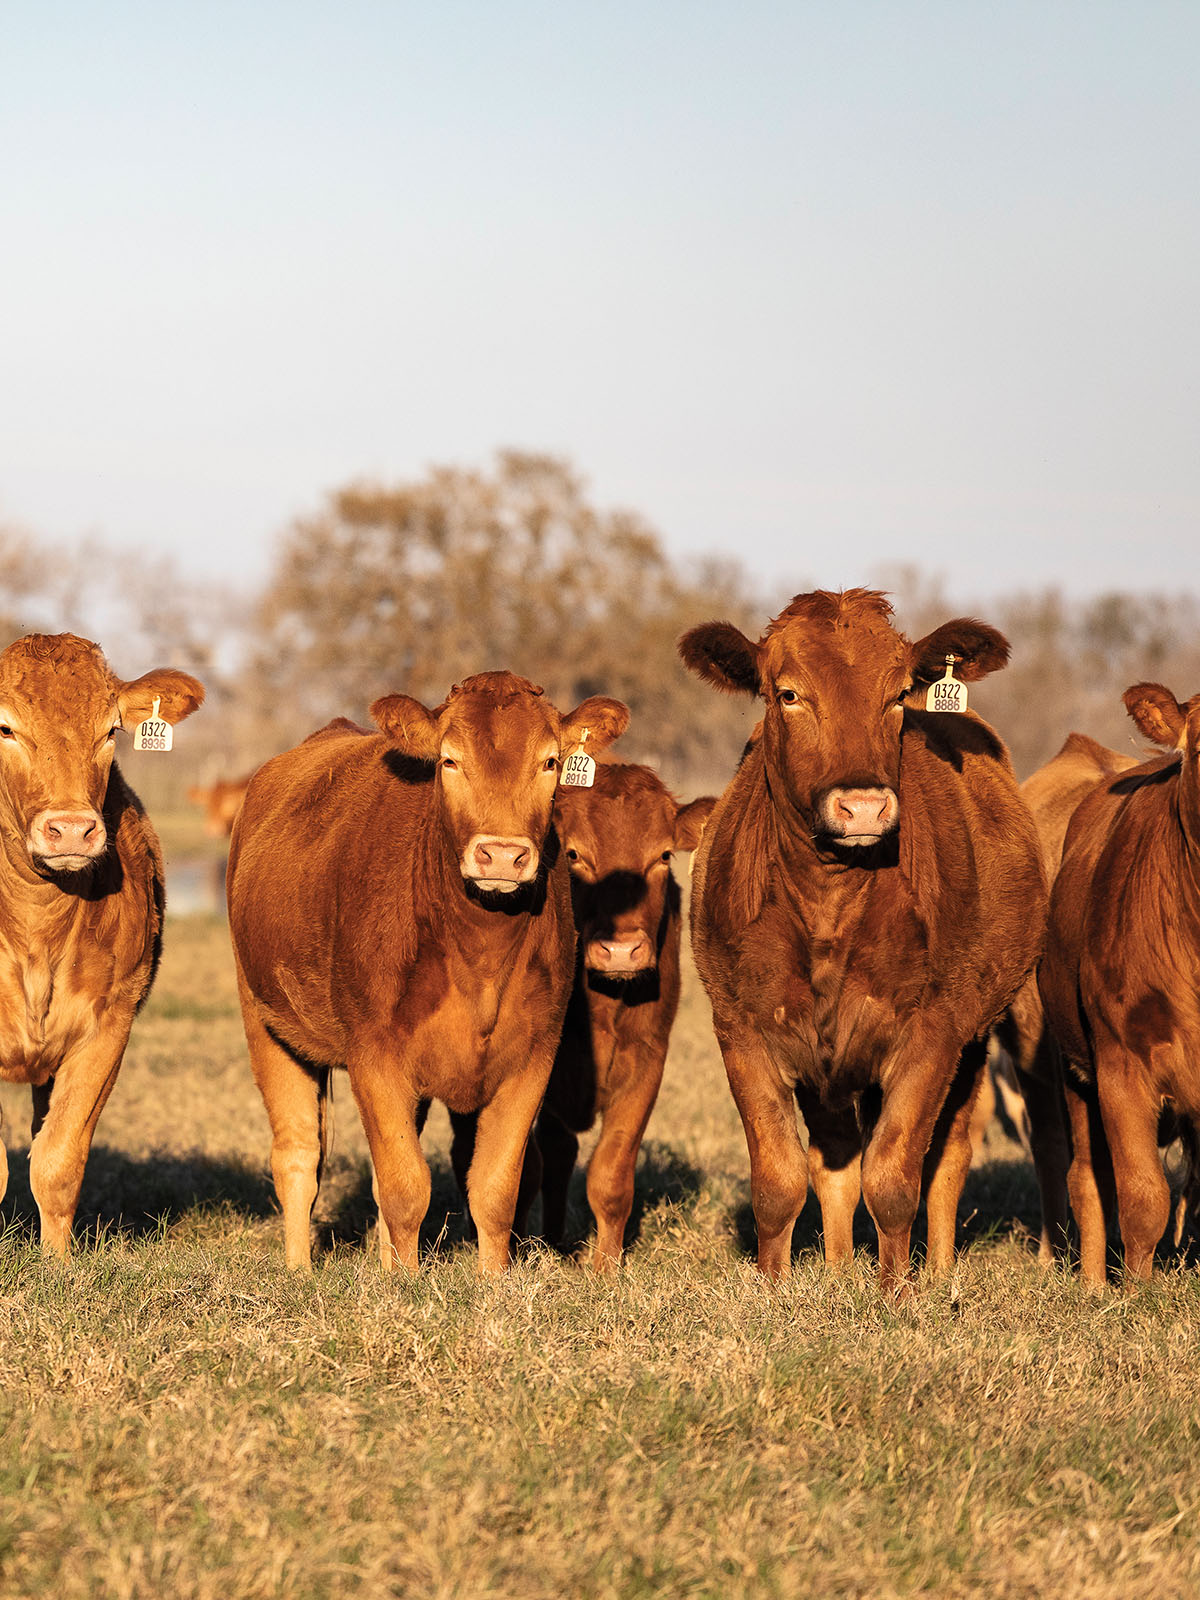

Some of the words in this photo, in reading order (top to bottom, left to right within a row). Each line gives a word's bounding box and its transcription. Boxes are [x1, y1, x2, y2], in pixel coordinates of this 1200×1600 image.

[934, 684, 960, 699] 0322
[934, 700, 960, 710] 8886
[141, 722, 166, 737] 0322
[141, 739, 166, 749] 8936
[566, 757, 590, 773] 0322
[565, 773, 587, 786] 8918
